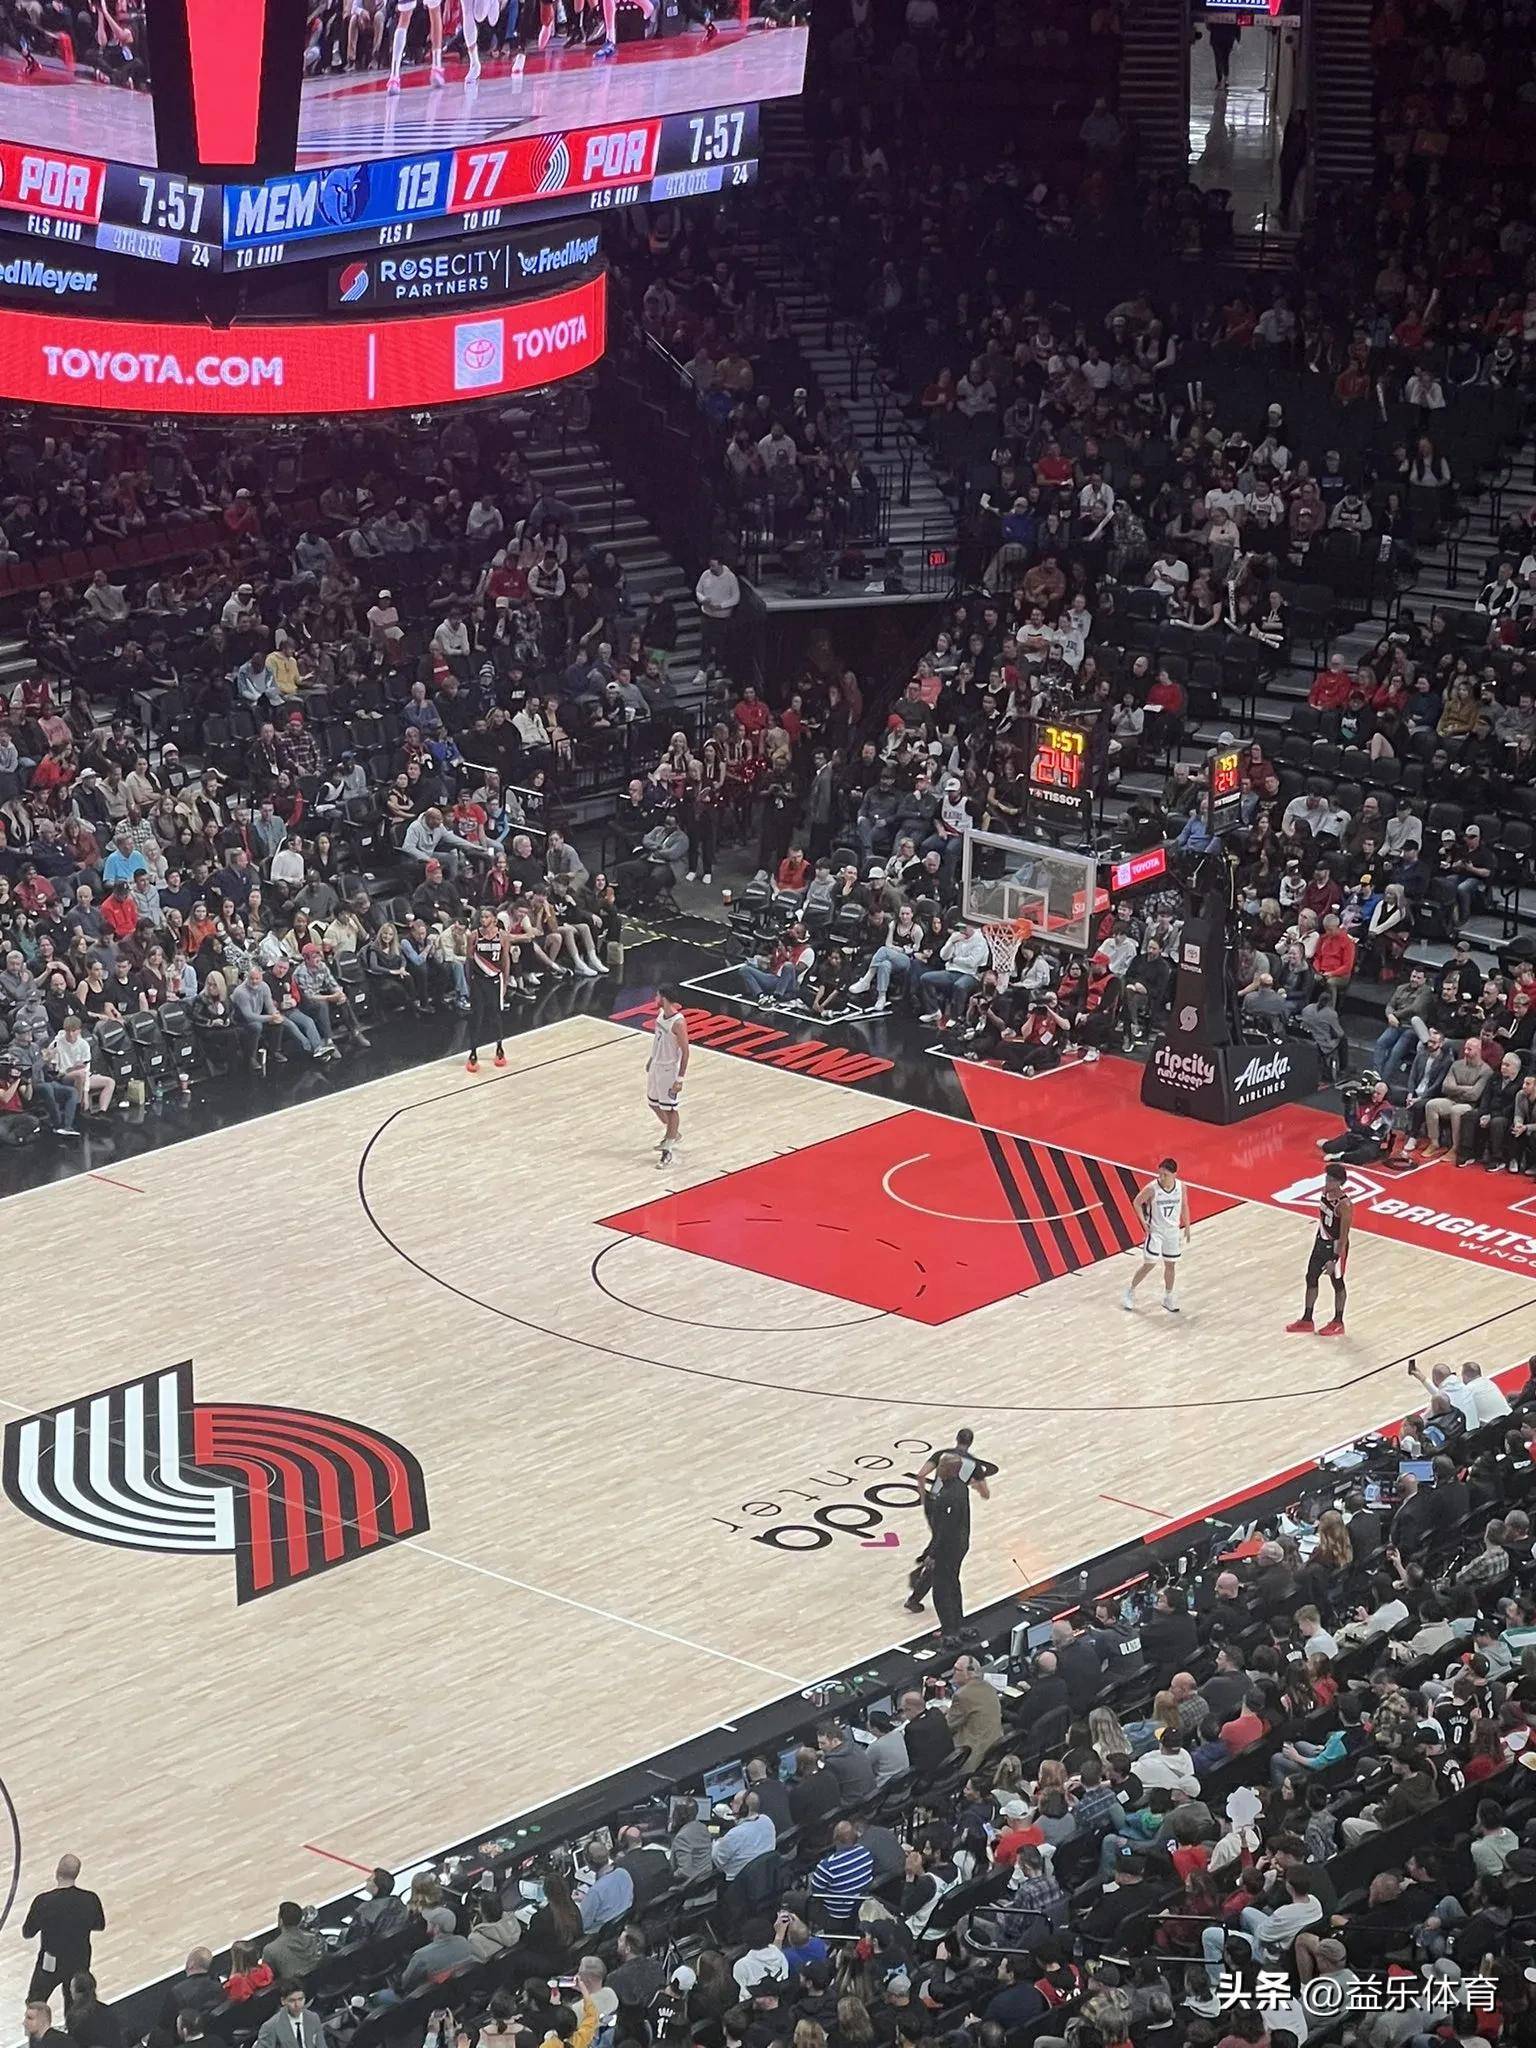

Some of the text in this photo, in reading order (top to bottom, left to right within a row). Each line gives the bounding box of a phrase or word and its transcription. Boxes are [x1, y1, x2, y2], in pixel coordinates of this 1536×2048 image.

[689, 111, 745, 164] 7:57
[583, 129, 649, 181] POR
[19, 156, 91, 211] POR
[396, 161, 441, 213] 113
[463, 150, 509, 200] 77
[732, 164, 749, 186] 24
[139, 175, 205, 235] 7:57
[235, 179, 318, 237] MEM
[590, 188, 612, 209] FLS
[28, 215, 51, 236] FLS
[463, 212, 478, 231] TO
[379, 226, 403, 245] FLS
[191, 244, 211, 268] 24
[236, 249, 252, 268] TO
[396, 277, 489, 299] PARTNERS
[512, 315, 588, 361] TOYOTA
[42, 346, 284, 386] TOYOTA.COM
[1045, 727, 1084, 755] 7:57
[1037, 745, 1079, 789] 24
[1042, 789, 1082, 808] TISSOT
[1131, 857, 1161, 875] TOYOTA
[1238, 1079, 1286, 1106] AIRLINES
[1163, 1205, 1175, 1218] 17
[750, 1472, 935, 1551] oda
